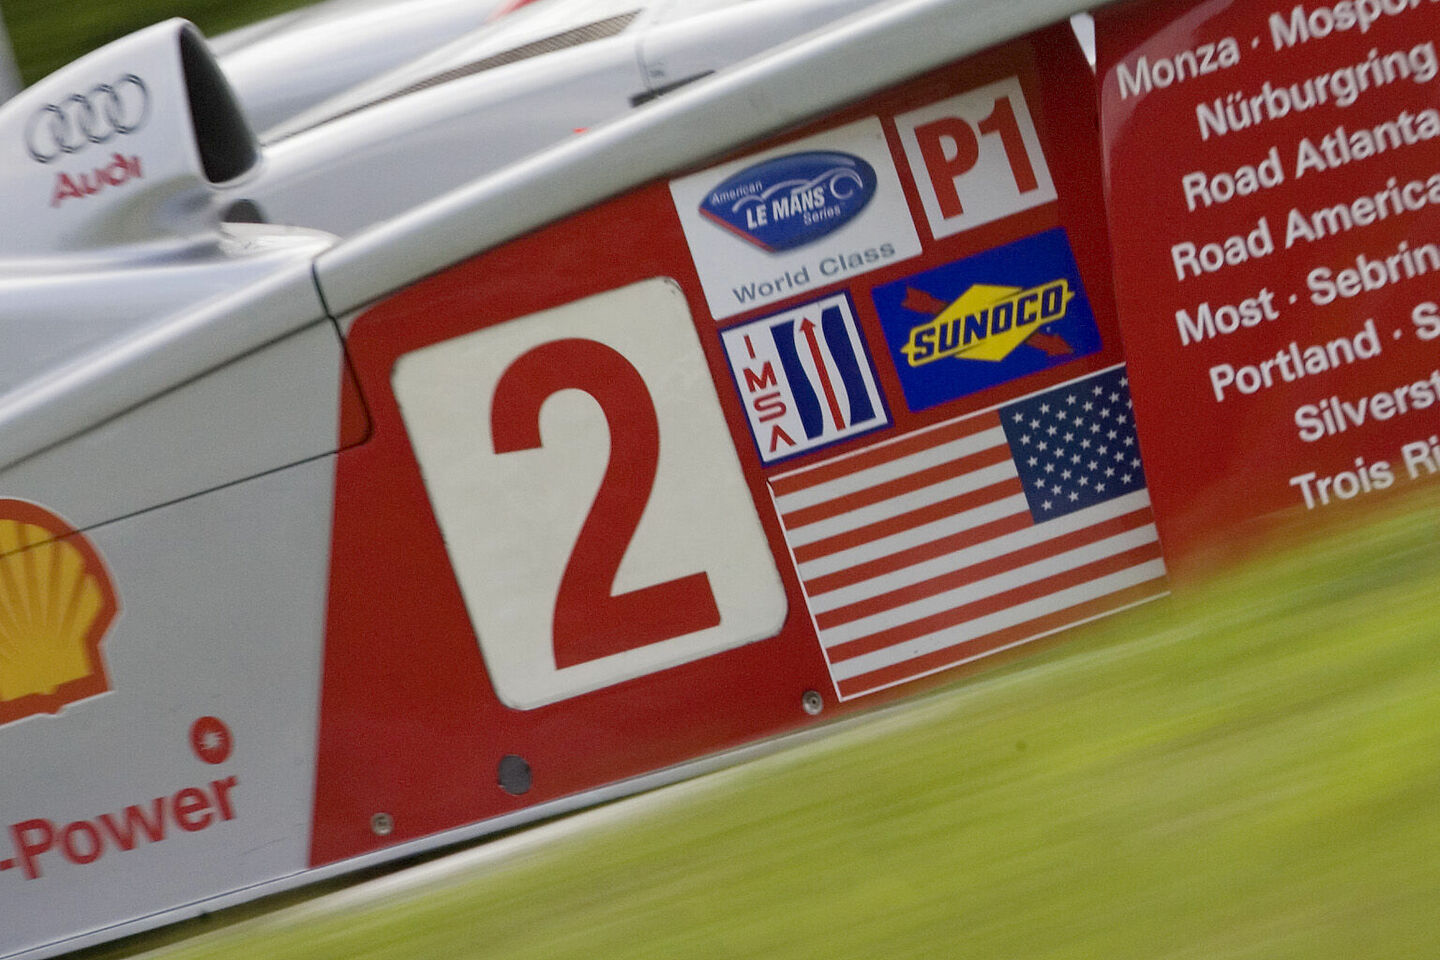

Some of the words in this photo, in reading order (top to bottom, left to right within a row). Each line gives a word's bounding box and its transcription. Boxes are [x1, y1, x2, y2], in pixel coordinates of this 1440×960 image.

[1116, 36, 1241, 101] Monza
[1196, 41, 1440, 140] Nürburgring
[50, 152, 144, 208] Audi
[913, 96, 1040, 221] P1
[1182, 147, 1285, 212] Road
[711, 180, 763, 206] American
[746, 204, 768, 229] LE
[772, 186, 828, 221] MANS
[803, 203, 841, 226] Series
[732, 266, 811, 306] World
[819, 241, 897, 278] Class
[1171, 216, 1275, 281] Road
[912, 289, 1064, 360] SUNOCO
[1175, 287, 1280, 346] Most
[742, 334, 797, 453] IMSA
[1209, 319, 1382, 403] Portland
[490, 337, 721, 671] 2
[1289, 457, 1394, 510] Trois
